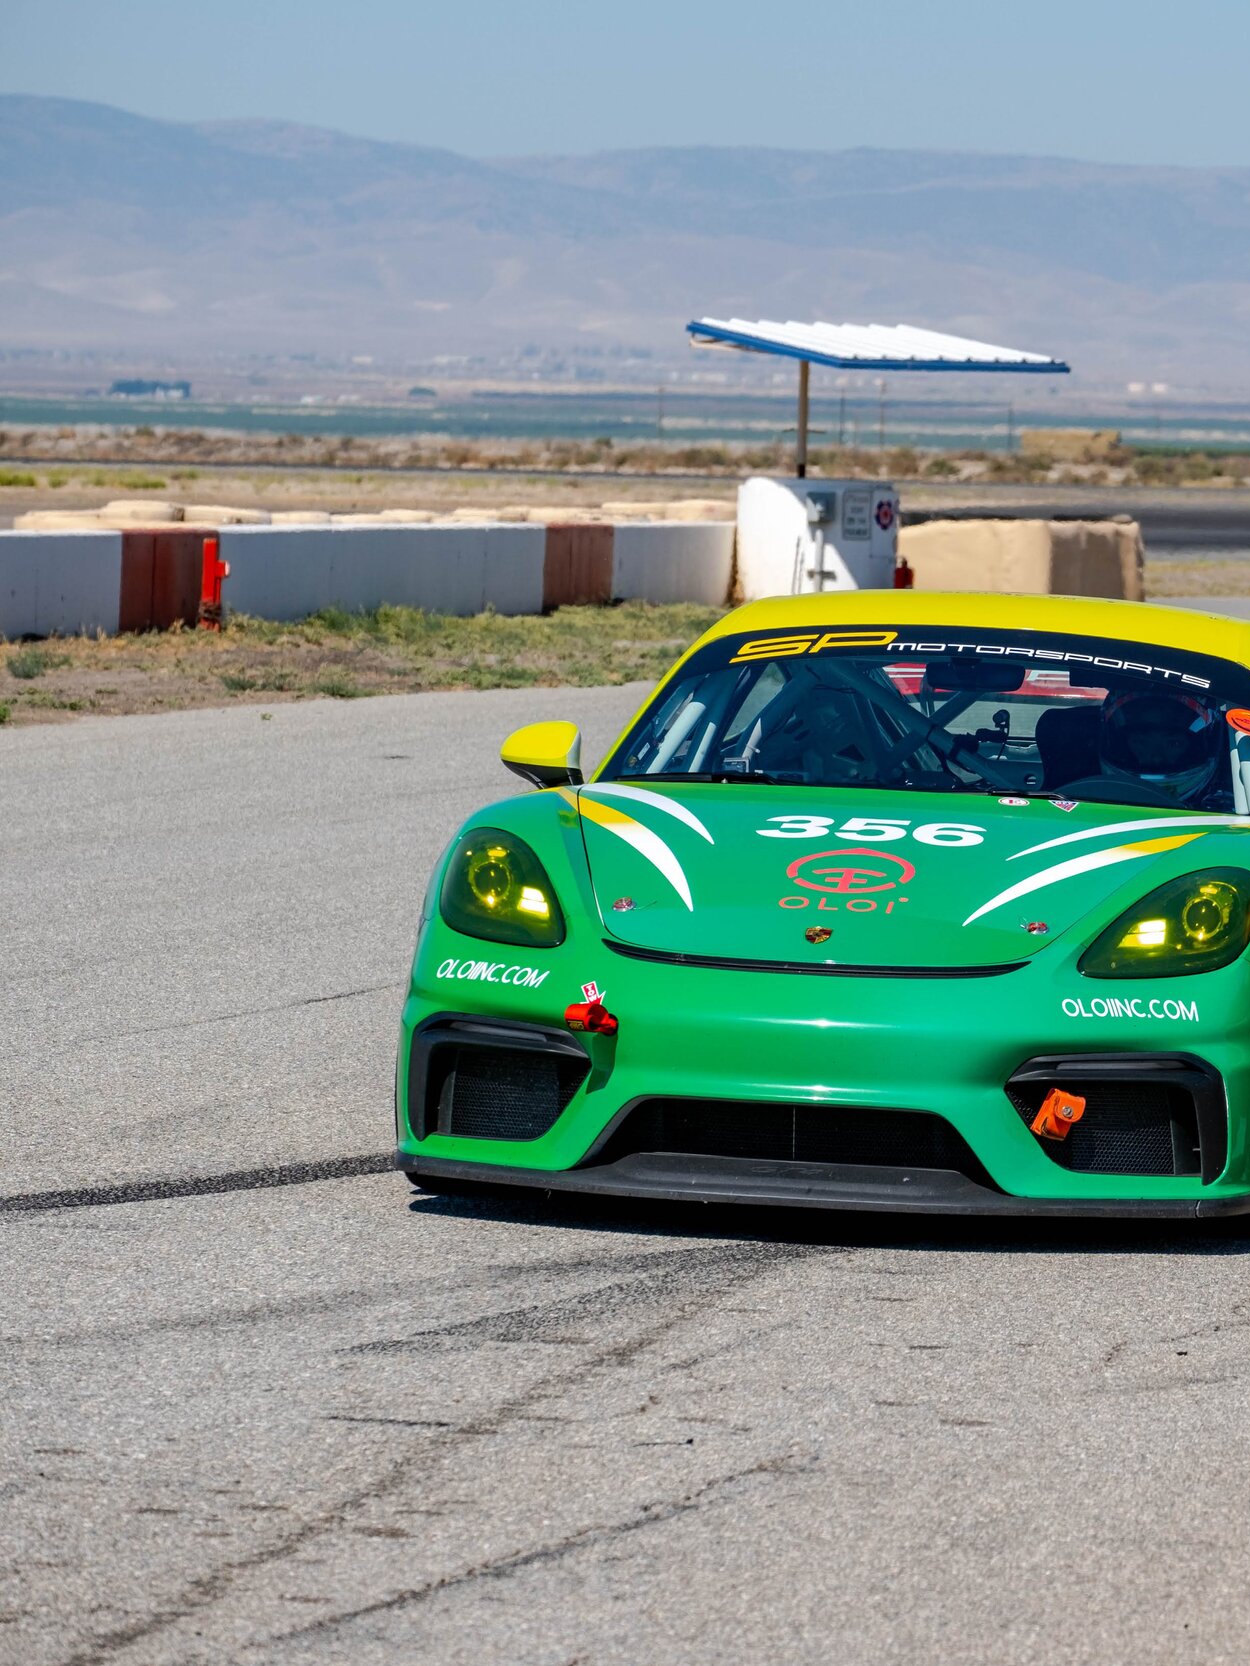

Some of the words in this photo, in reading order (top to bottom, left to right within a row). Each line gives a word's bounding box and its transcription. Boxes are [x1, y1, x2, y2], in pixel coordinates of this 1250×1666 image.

[729, 631, 899, 664] SP
[886, 642, 1211, 690] MOTORSPORTS
[755, 815, 988, 848] 356
[585, 984, 598, 1002] TOW
